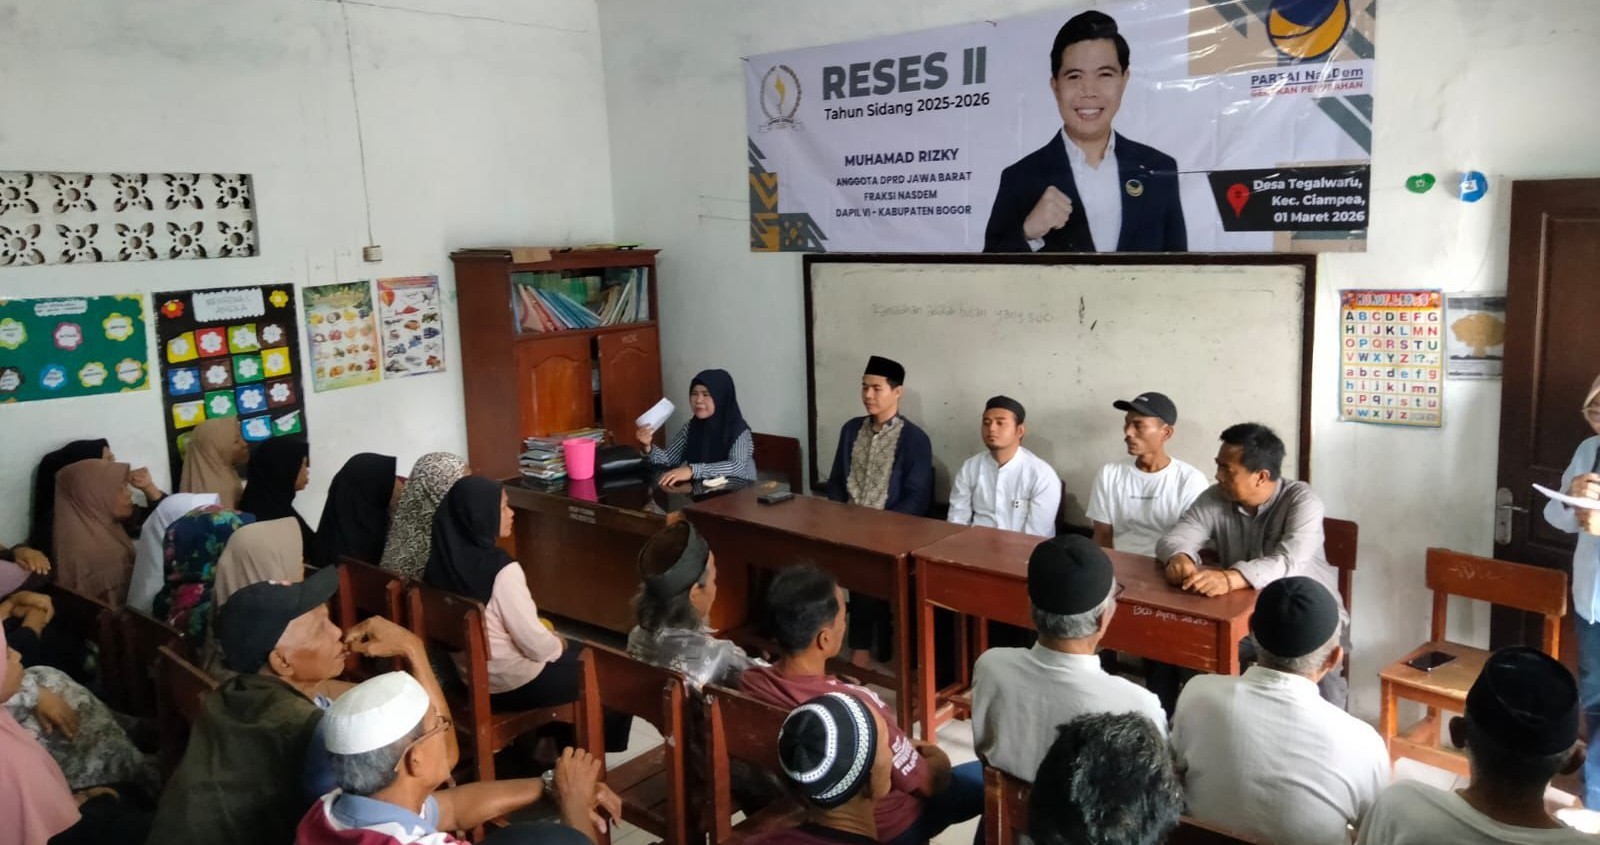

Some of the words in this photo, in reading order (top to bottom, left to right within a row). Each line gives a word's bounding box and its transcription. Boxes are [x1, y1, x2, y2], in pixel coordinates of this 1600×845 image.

[822, 51, 949, 100] RESES
[962, 46, 987, 85] II
[1251, 71, 1299, 85] PARTAI
[824, 106, 863, 120] Tahun
[867, 102, 912, 116] Sidang
[917, 92, 990, 112] 2025-2026
[844, 152, 914, 167] MUHAMAD
[919, 148, 959, 162] RIZKY
[836, 176, 878, 186] ANGGOTA
[880, 175, 905, 184] DPRD
[906, 173, 937, 183] JAWA
[938, 171, 972, 182] BARAT
[1253, 180, 1285, 190] Desa
[1288, 177, 1362, 190] Tegalwaru,
[864, 191, 896, 201] FRAKSI
[898, 189, 937, 200] NASDEM
[1272, 195, 1299, 206] Kec.
[1303, 194, 1365, 207] Ciampea,
[836, 208, 861, 217] DAPIL
[862, 208, 871, 217] VI
[878, 206, 934, 216] KABUPATEN
[936, 205, 972, 215] BOGOR
[1274, 212, 1287, 222] 01
[1291, 212, 1329, 222] Maret
[1331, 210, 1365, 222] 2026
[1346, 311, 1354, 321] A
[1359, 312, 1367, 320] B
[1372, 312, 1380, 321] C
[1386, 312, 1394, 321] D
[1400, 312, 1408, 321] E
[1414, 312, 1421, 321] F
[1428, 312, 1437, 321] G
[1346, 325, 1354, 334] H
[1373, 326, 1380, 334] J
[1386, 326, 1394, 335] K
[1401, 327, 1408, 336] L
[1413, 327, 1423, 336] M
[1428, 327, 1437, 336] N
[1346, 339, 1355, 348] O
[1360, 339, 1367, 347] P
[1386, 340, 1394, 349] R
[1400, 340, 1408, 350] S
[1414, 340, 1422, 350] T
[1428, 341, 1437, 350] U
[1346, 352, 1354, 361] V
[1359, 353, 1368, 361] W
[1373, 353, 1380, 362] X
[1387, 354, 1394, 362] Y
[1400, 354, 1408, 363] Z
[1346, 369, 1354, 378] a
[1360, 368, 1367, 377] b
[1387, 368, 1395, 378] d
[1401, 370, 1408, 378] e
[1416, 369, 1421, 378] f
[1429, 370, 1437, 379] g
[1346, 380, 1354, 390] h
[1387, 382, 1394, 391] k
[1412, 385, 1424, 393] m
[1428, 386, 1436, 394] n
[1372, 395, 1380, 405] q
[1416, 398, 1421, 407] t
[1428, 400, 1436, 408] u
[1387, 410, 1393, 419] y
